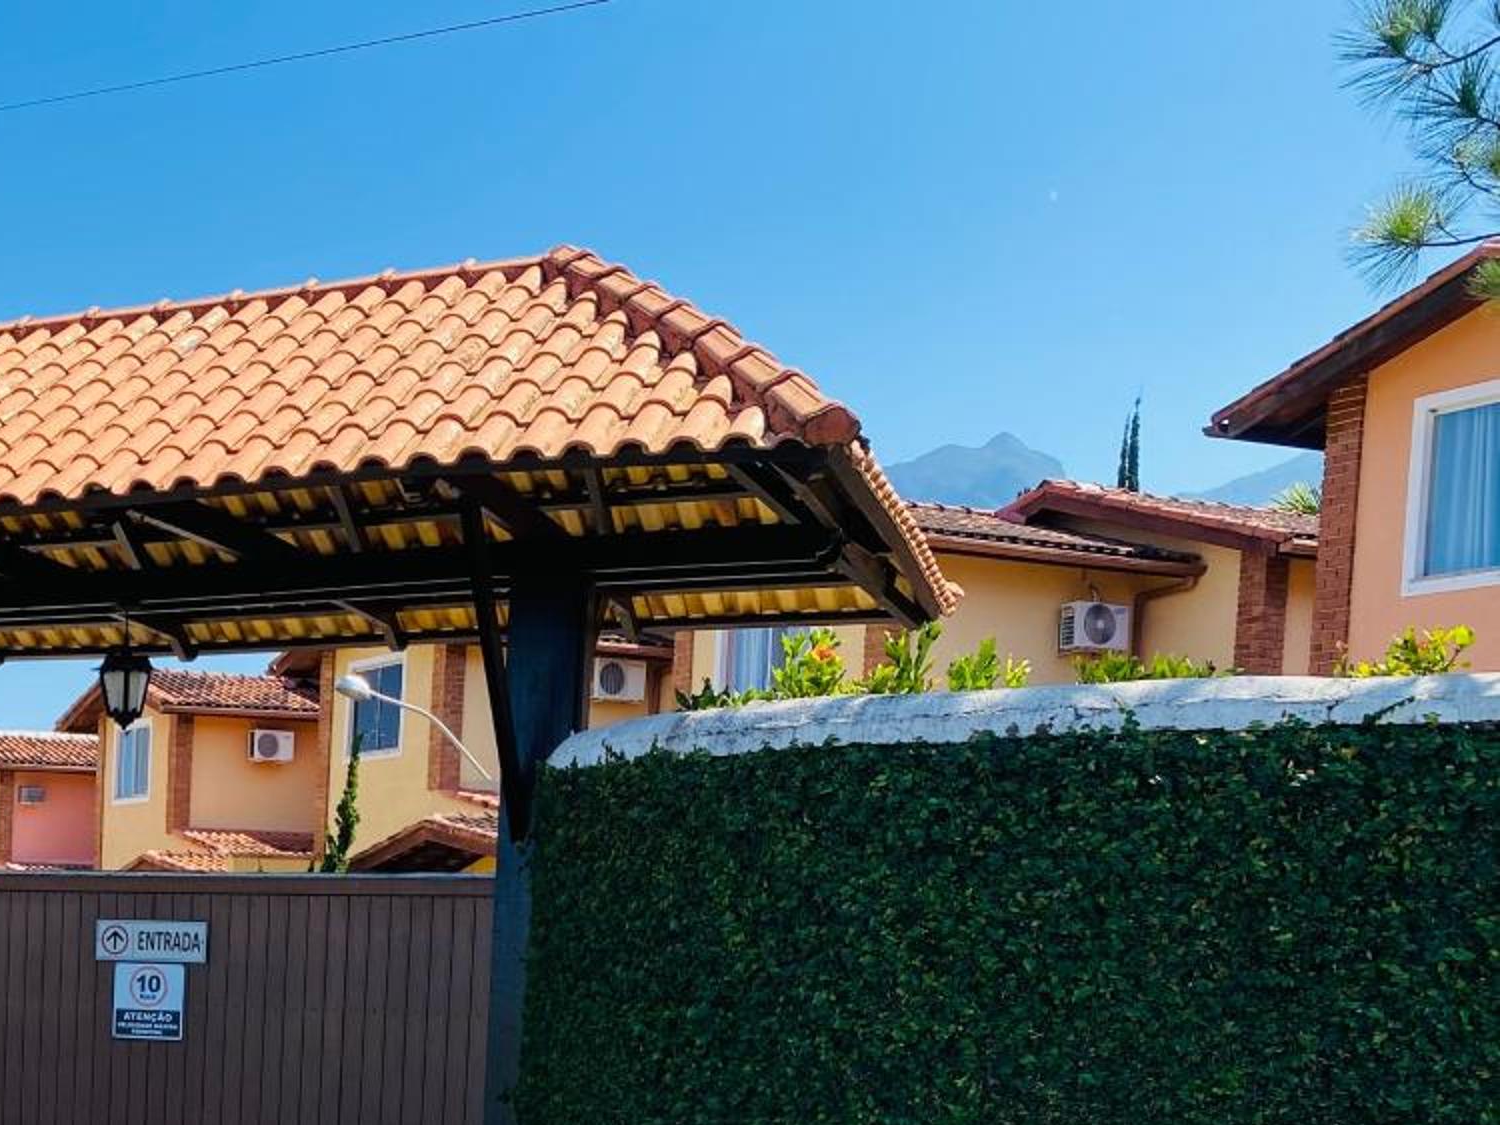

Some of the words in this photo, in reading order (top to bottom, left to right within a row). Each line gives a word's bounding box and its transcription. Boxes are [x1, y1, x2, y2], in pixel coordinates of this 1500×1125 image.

[137, 930, 201, 952] ENTRADA
[137, 975, 161, 993] 10
[123, 1011, 173, 1023] ATENÇÃO
